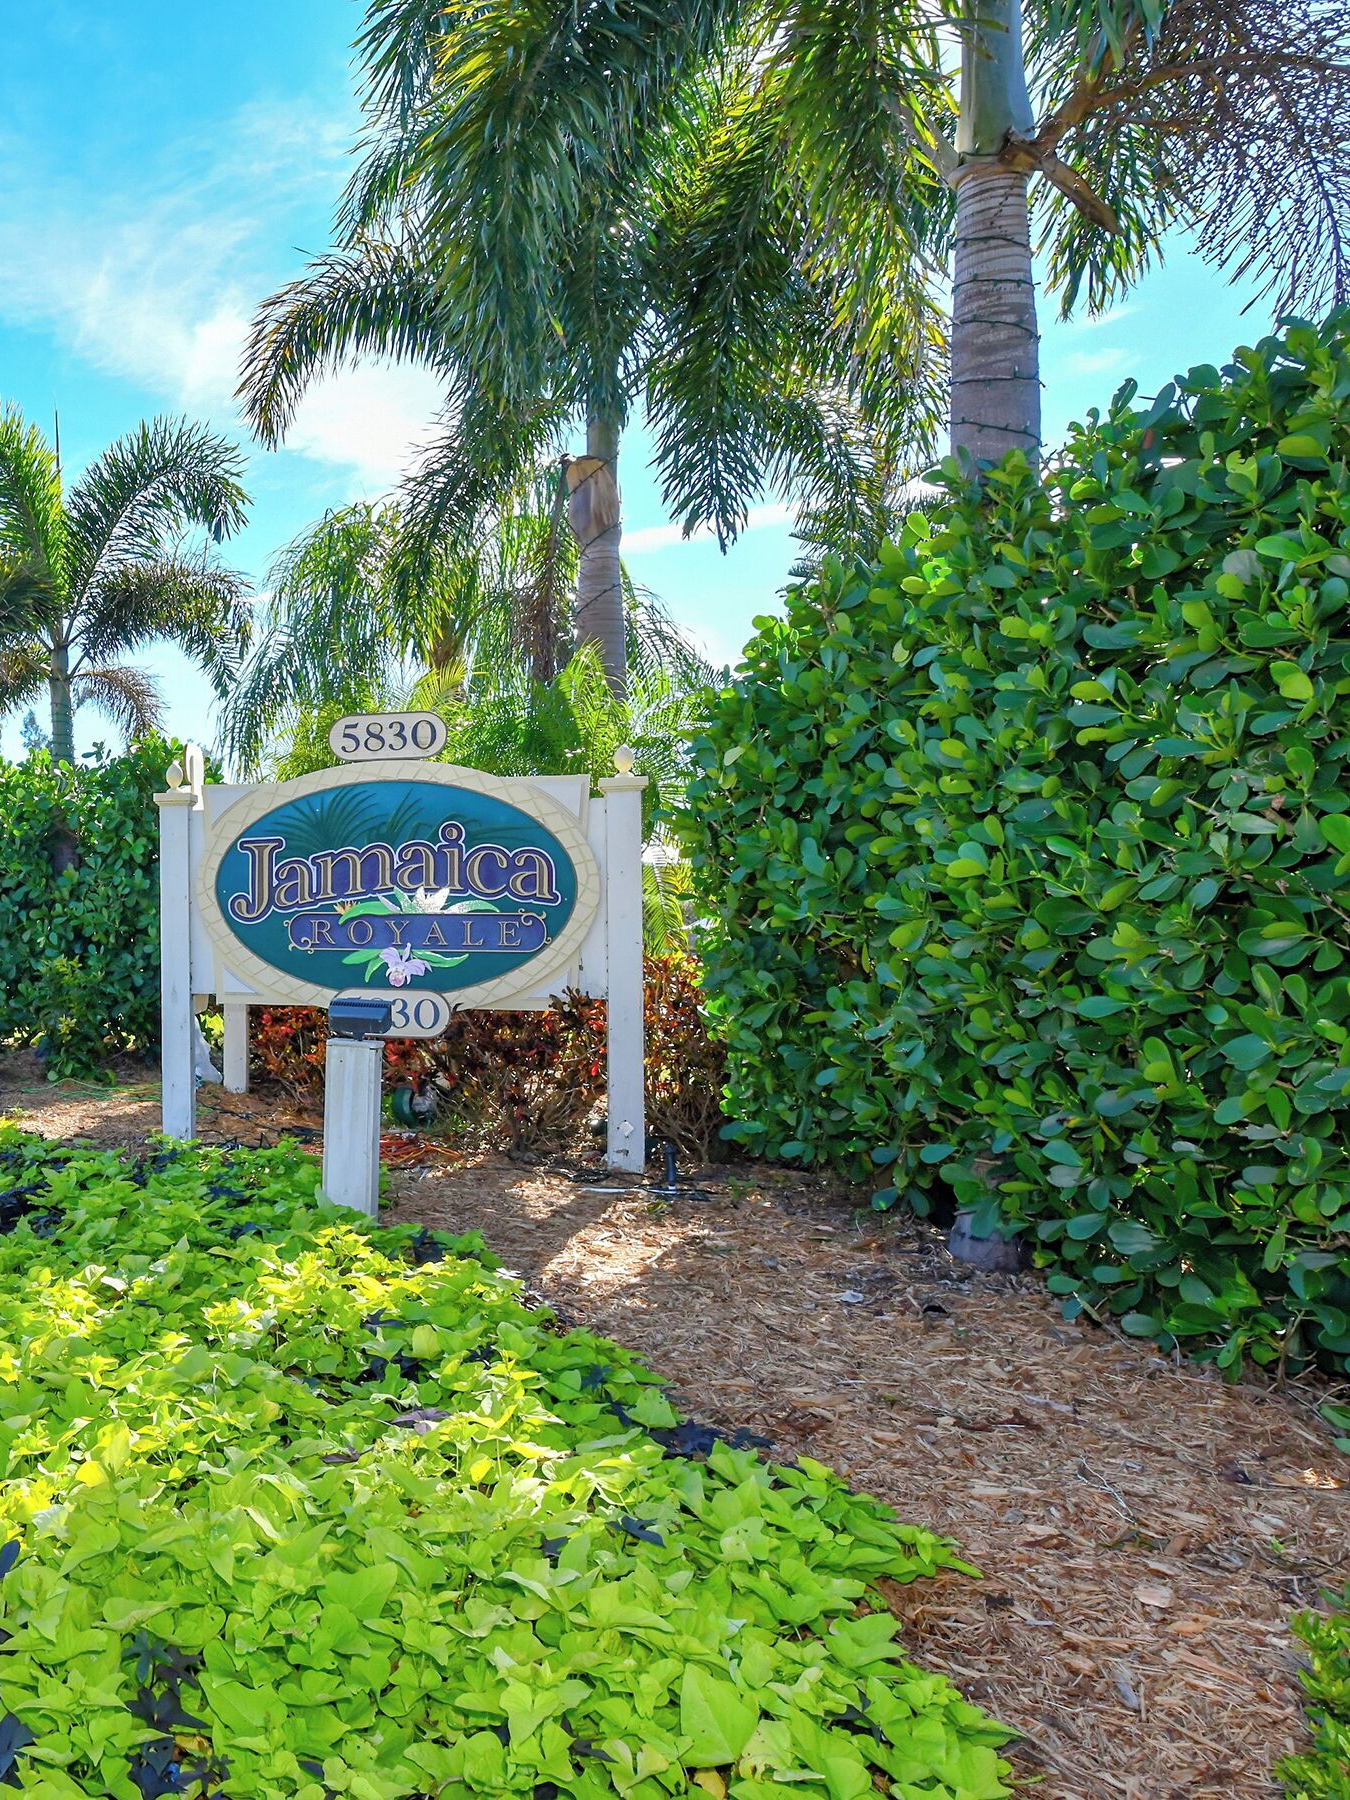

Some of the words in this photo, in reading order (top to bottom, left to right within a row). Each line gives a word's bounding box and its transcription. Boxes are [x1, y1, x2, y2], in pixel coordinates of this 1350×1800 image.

[341, 719, 437, 753] 5830
[231, 823, 559, 921] Jamaica
[310, 919, 523, 946] ROYALE
